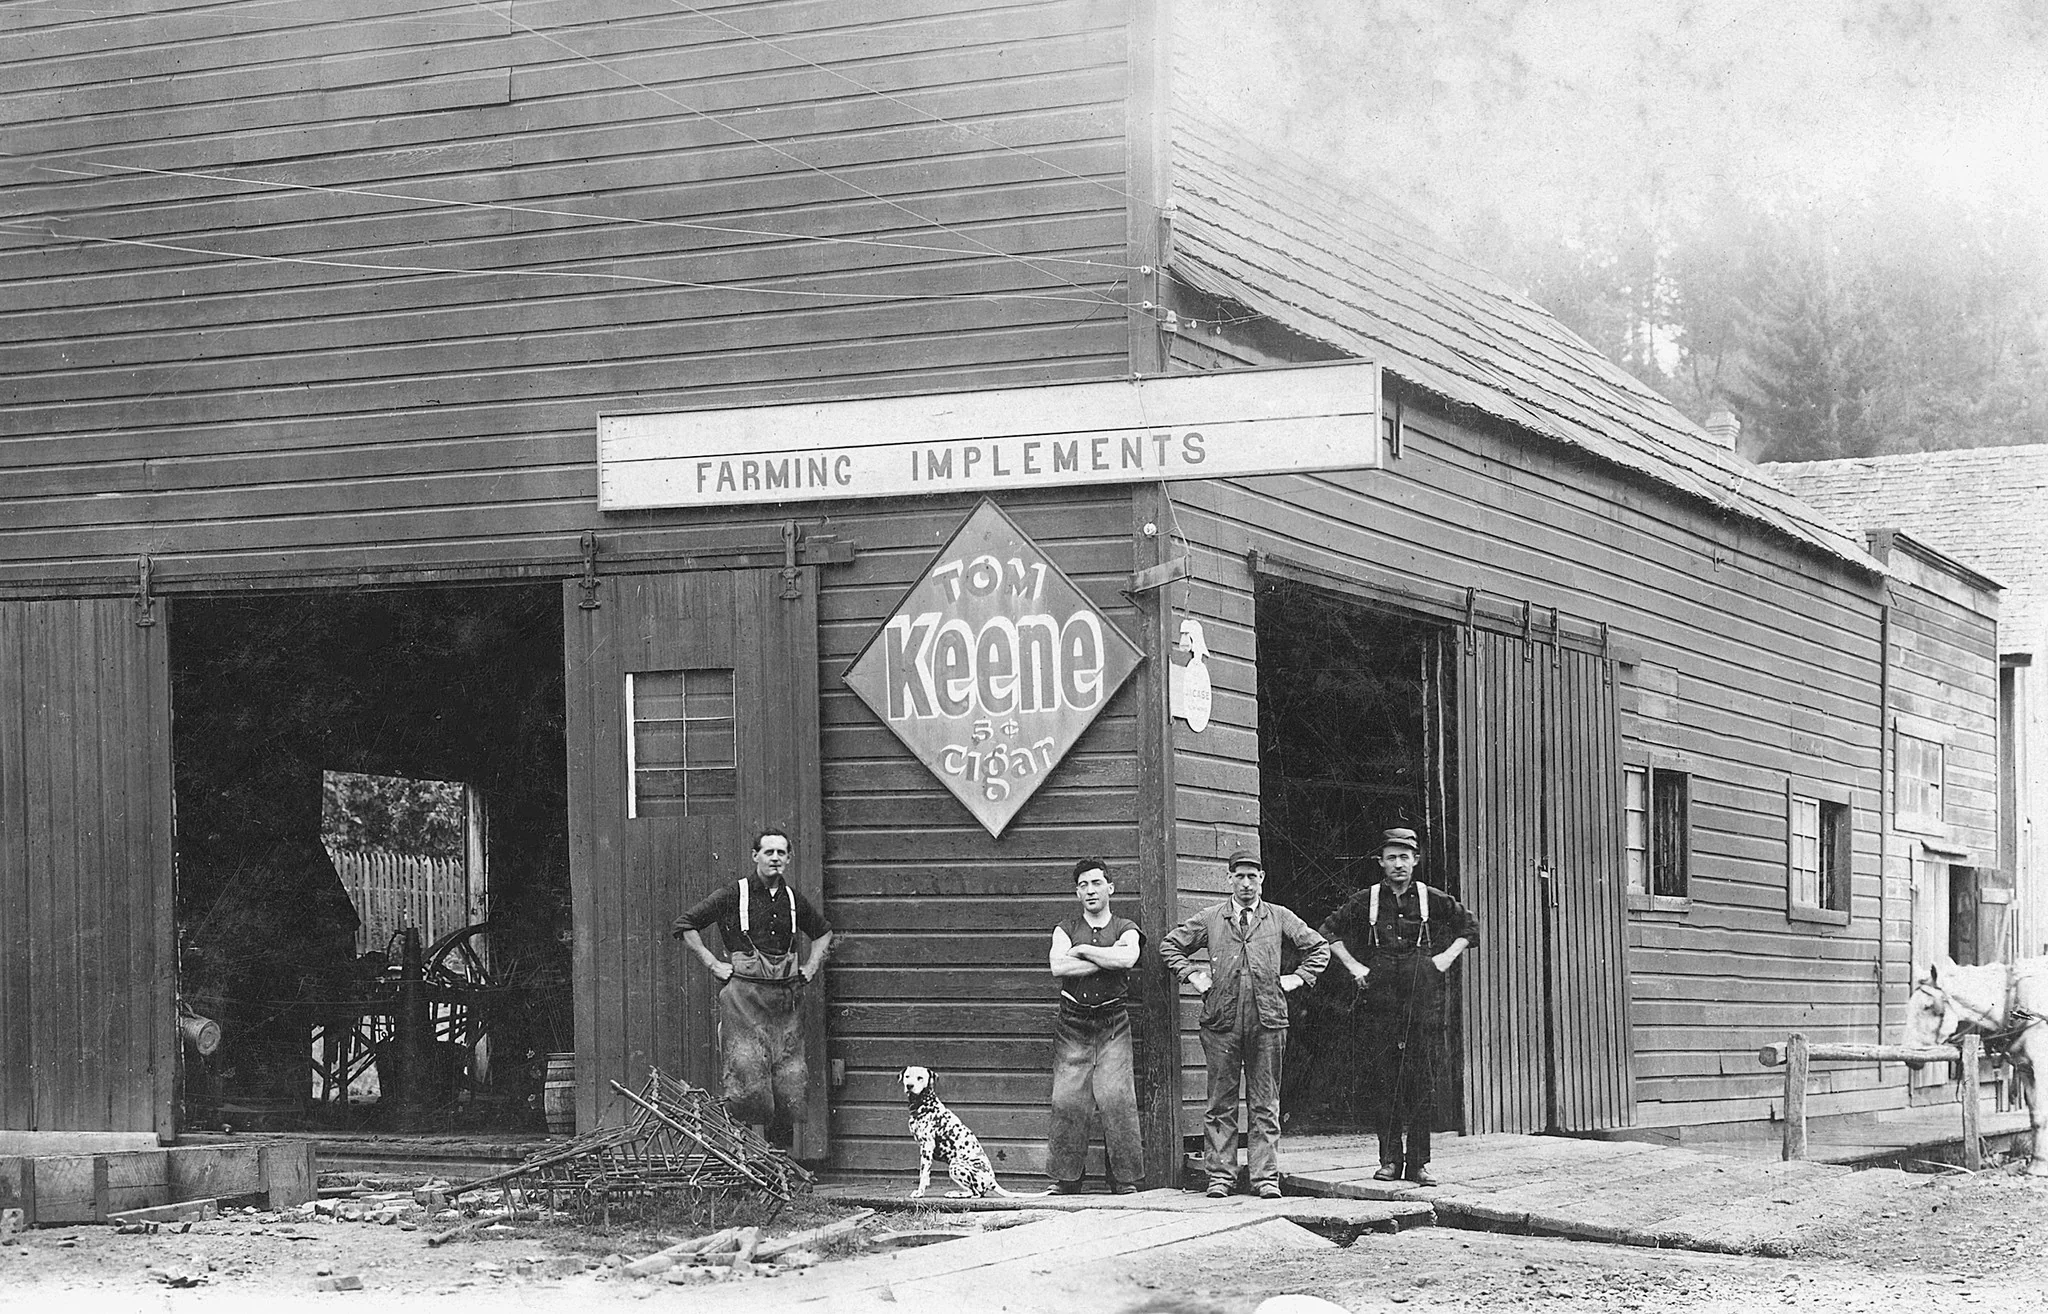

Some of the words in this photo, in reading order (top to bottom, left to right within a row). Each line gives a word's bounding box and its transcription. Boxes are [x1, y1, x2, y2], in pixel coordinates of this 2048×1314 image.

[697, 455, 852, 493] FARMING
[912, 432, 1206, 481] IMPLEMENTS
[932, 555, 1047, 603] TOM
[885, 610, 1104, 721] Keene
